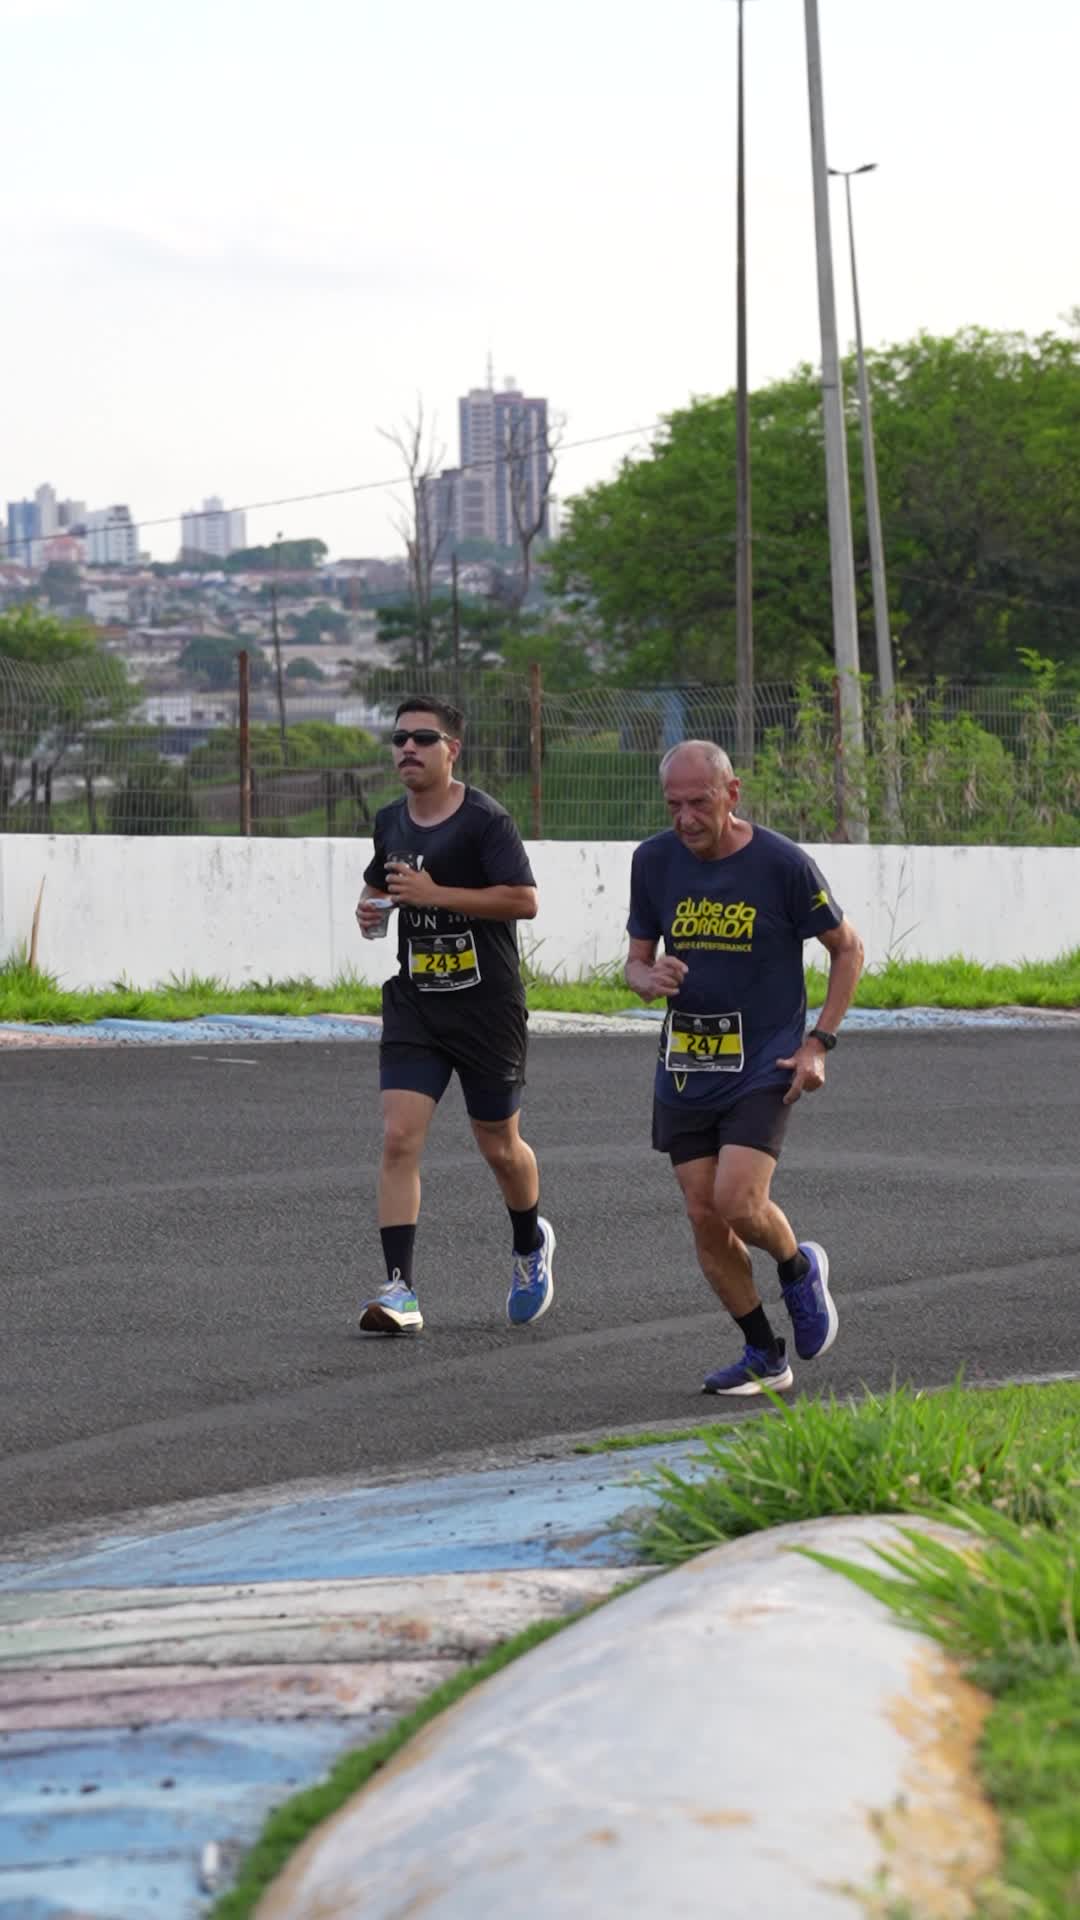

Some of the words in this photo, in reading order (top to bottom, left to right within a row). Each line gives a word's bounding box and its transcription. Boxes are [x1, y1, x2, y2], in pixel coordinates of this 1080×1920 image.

[671, 917, 753, 939] CORRIDA
[425, 954, 461, 972] 243
[687, 1035, 724, 1055] 247
